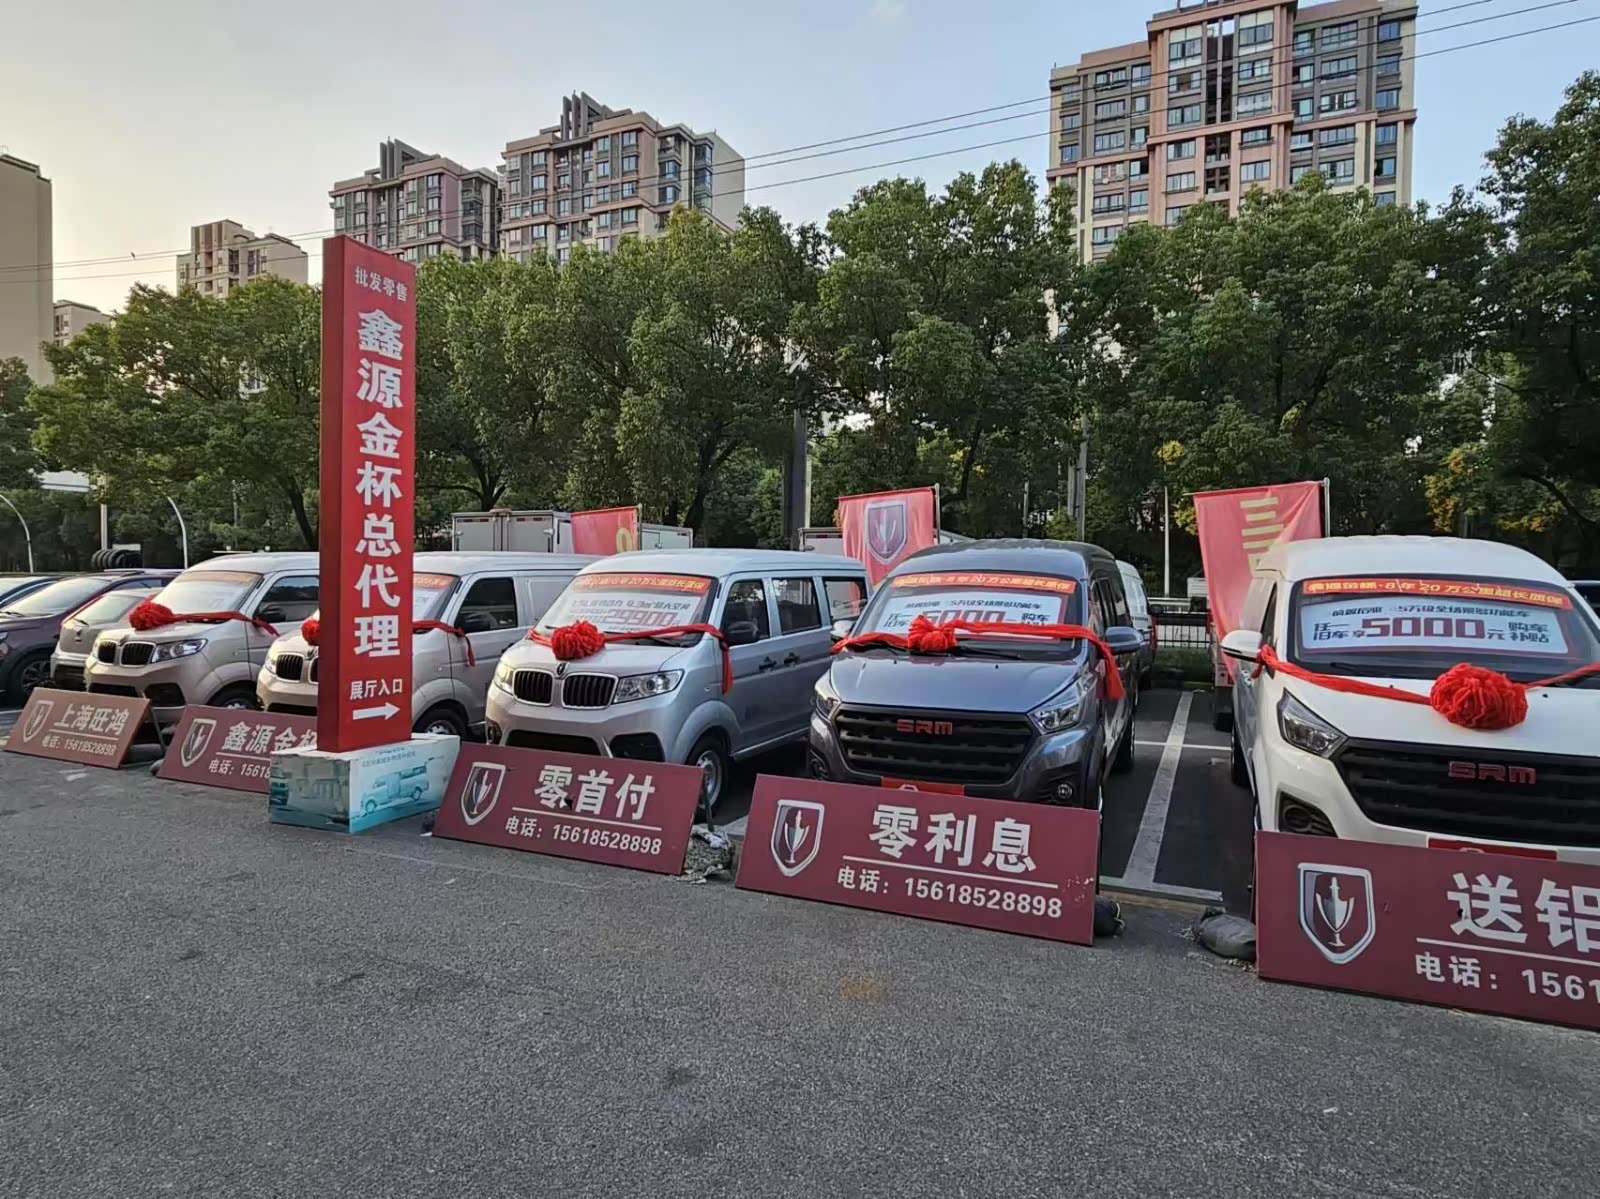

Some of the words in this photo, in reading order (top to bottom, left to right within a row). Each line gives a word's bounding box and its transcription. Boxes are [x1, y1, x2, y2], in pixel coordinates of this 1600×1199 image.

[355, 266, 408, 302] 批发零售
[354, 309, 404, 657] 鑫源金杯总代理
[350, 678, 403, 700] 展厅入口
[53, 704, 130, 736] 上海旺鸿
[896, 719, 953, 735] SRM
[1448, 761, 1537, 784] SRM
[534, 764, 657, 820] 零首付
[868, 804, 1037, 873] 零利息
[1447, 872, 1600, 953] 送铝
